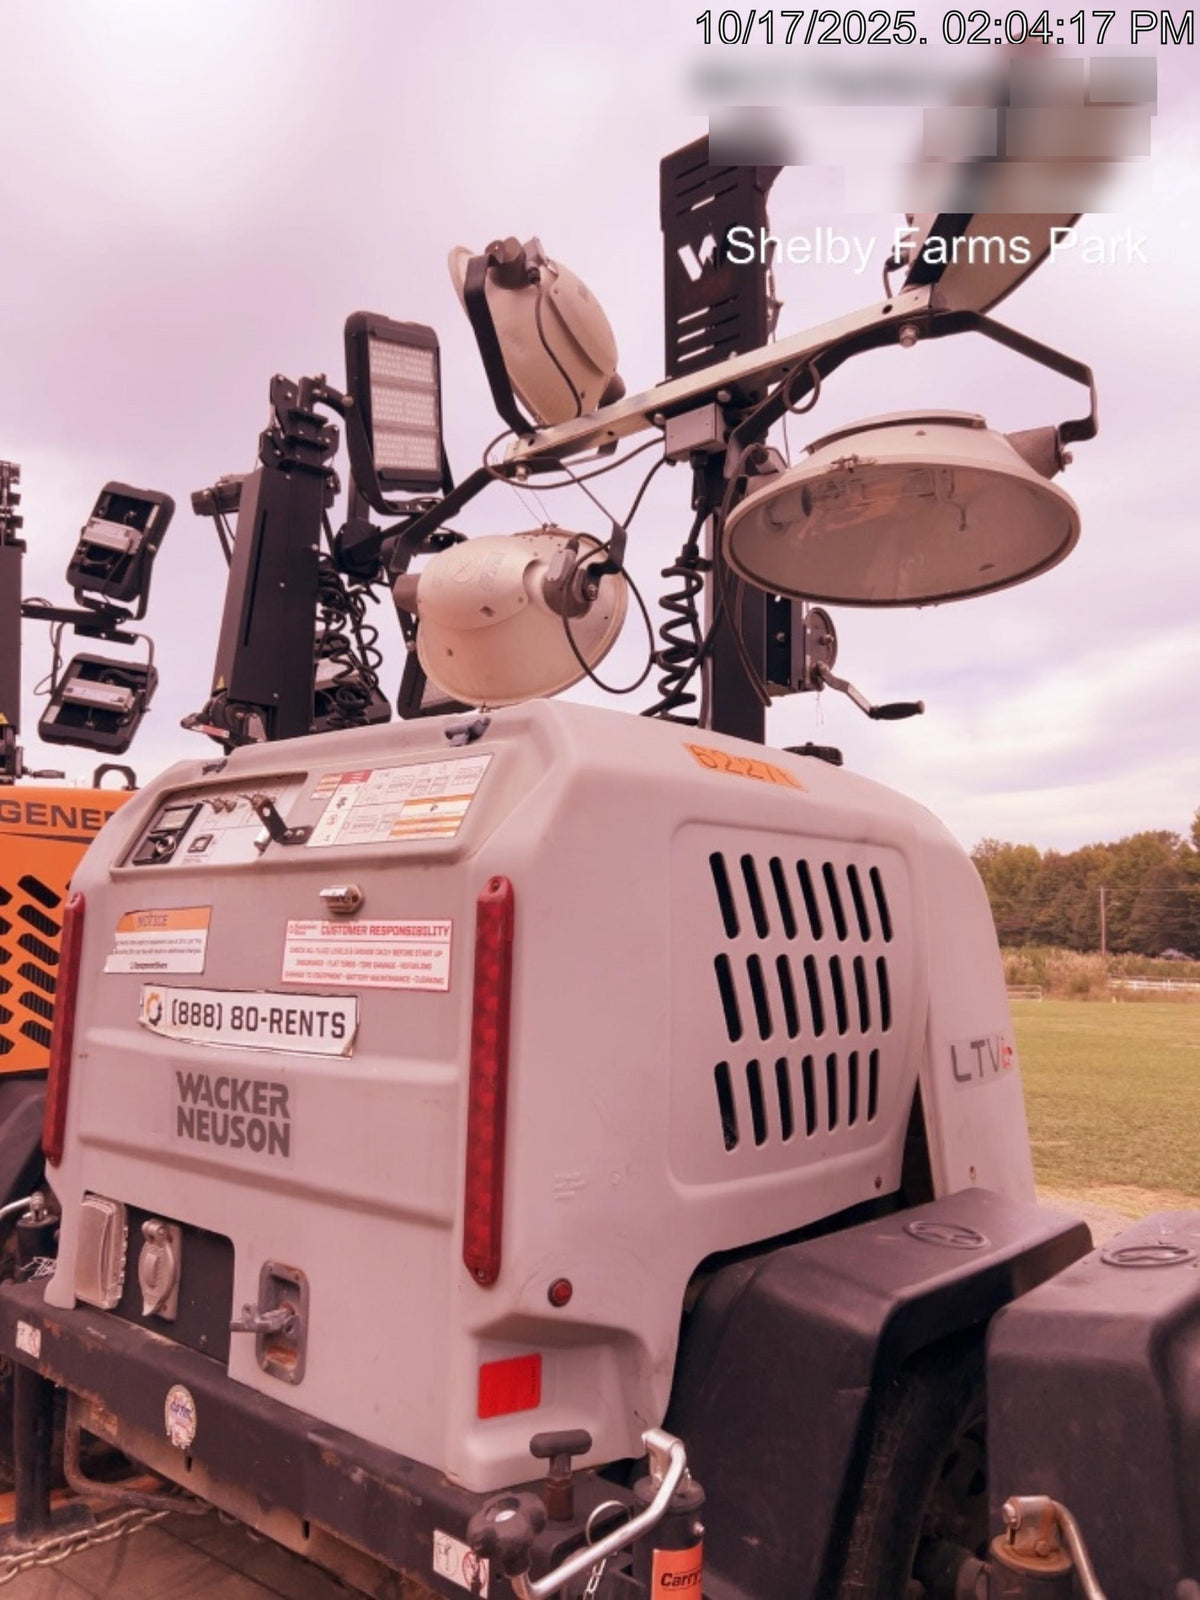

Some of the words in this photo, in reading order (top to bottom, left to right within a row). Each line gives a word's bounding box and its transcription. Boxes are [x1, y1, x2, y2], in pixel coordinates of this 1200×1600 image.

[321, 925, 368, 936] CUSTOMER
[369, 925, 450, 937] RESPONSIBILITY
[171, 998, 222, 1031] (888)
[230, 1004, 347, 1041] 80-RENTS
[175, 1070, 290, 1121] WACKER
[176, 1111, 291, 1158] NEUSON
